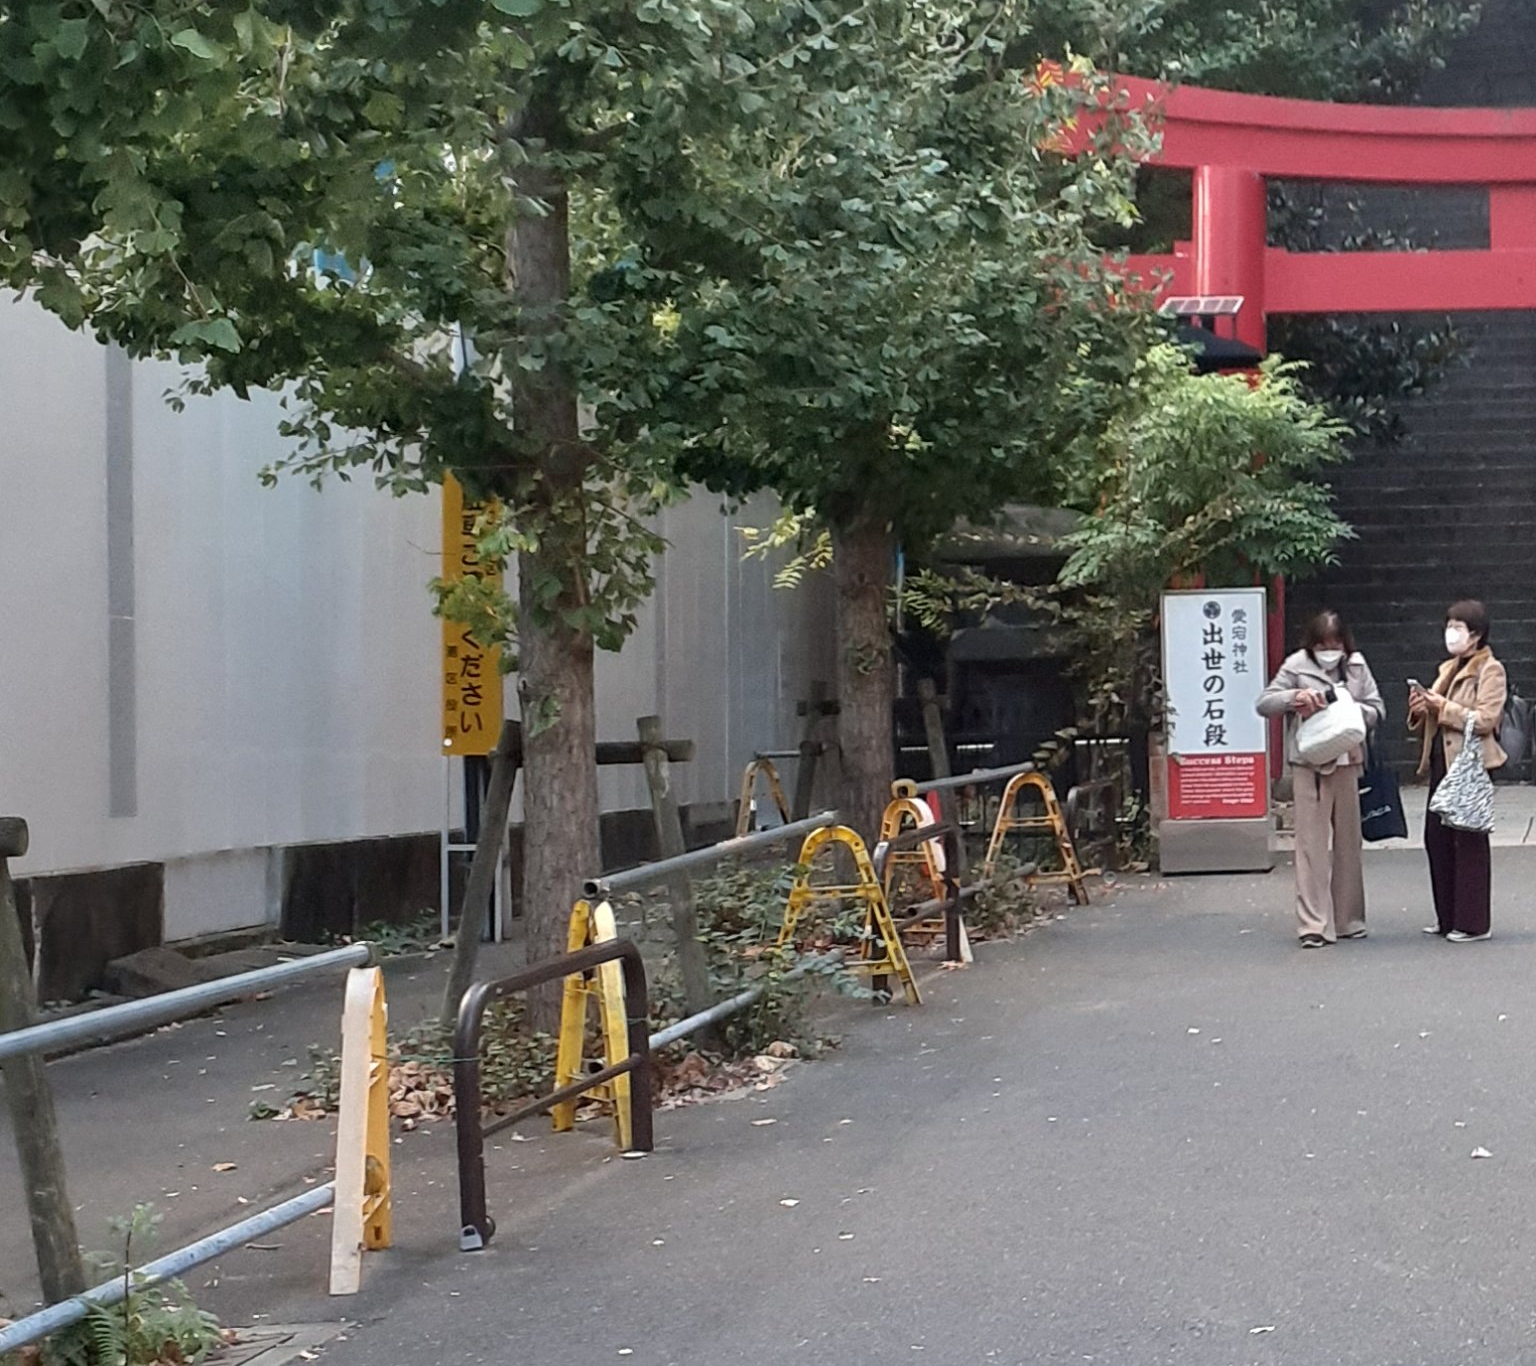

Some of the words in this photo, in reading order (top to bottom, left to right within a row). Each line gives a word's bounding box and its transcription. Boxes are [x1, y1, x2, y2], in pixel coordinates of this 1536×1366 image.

[1202, 622, 1228, 747] 出世の石段
[1231, 609, 1249, 674] 愛宕神社
